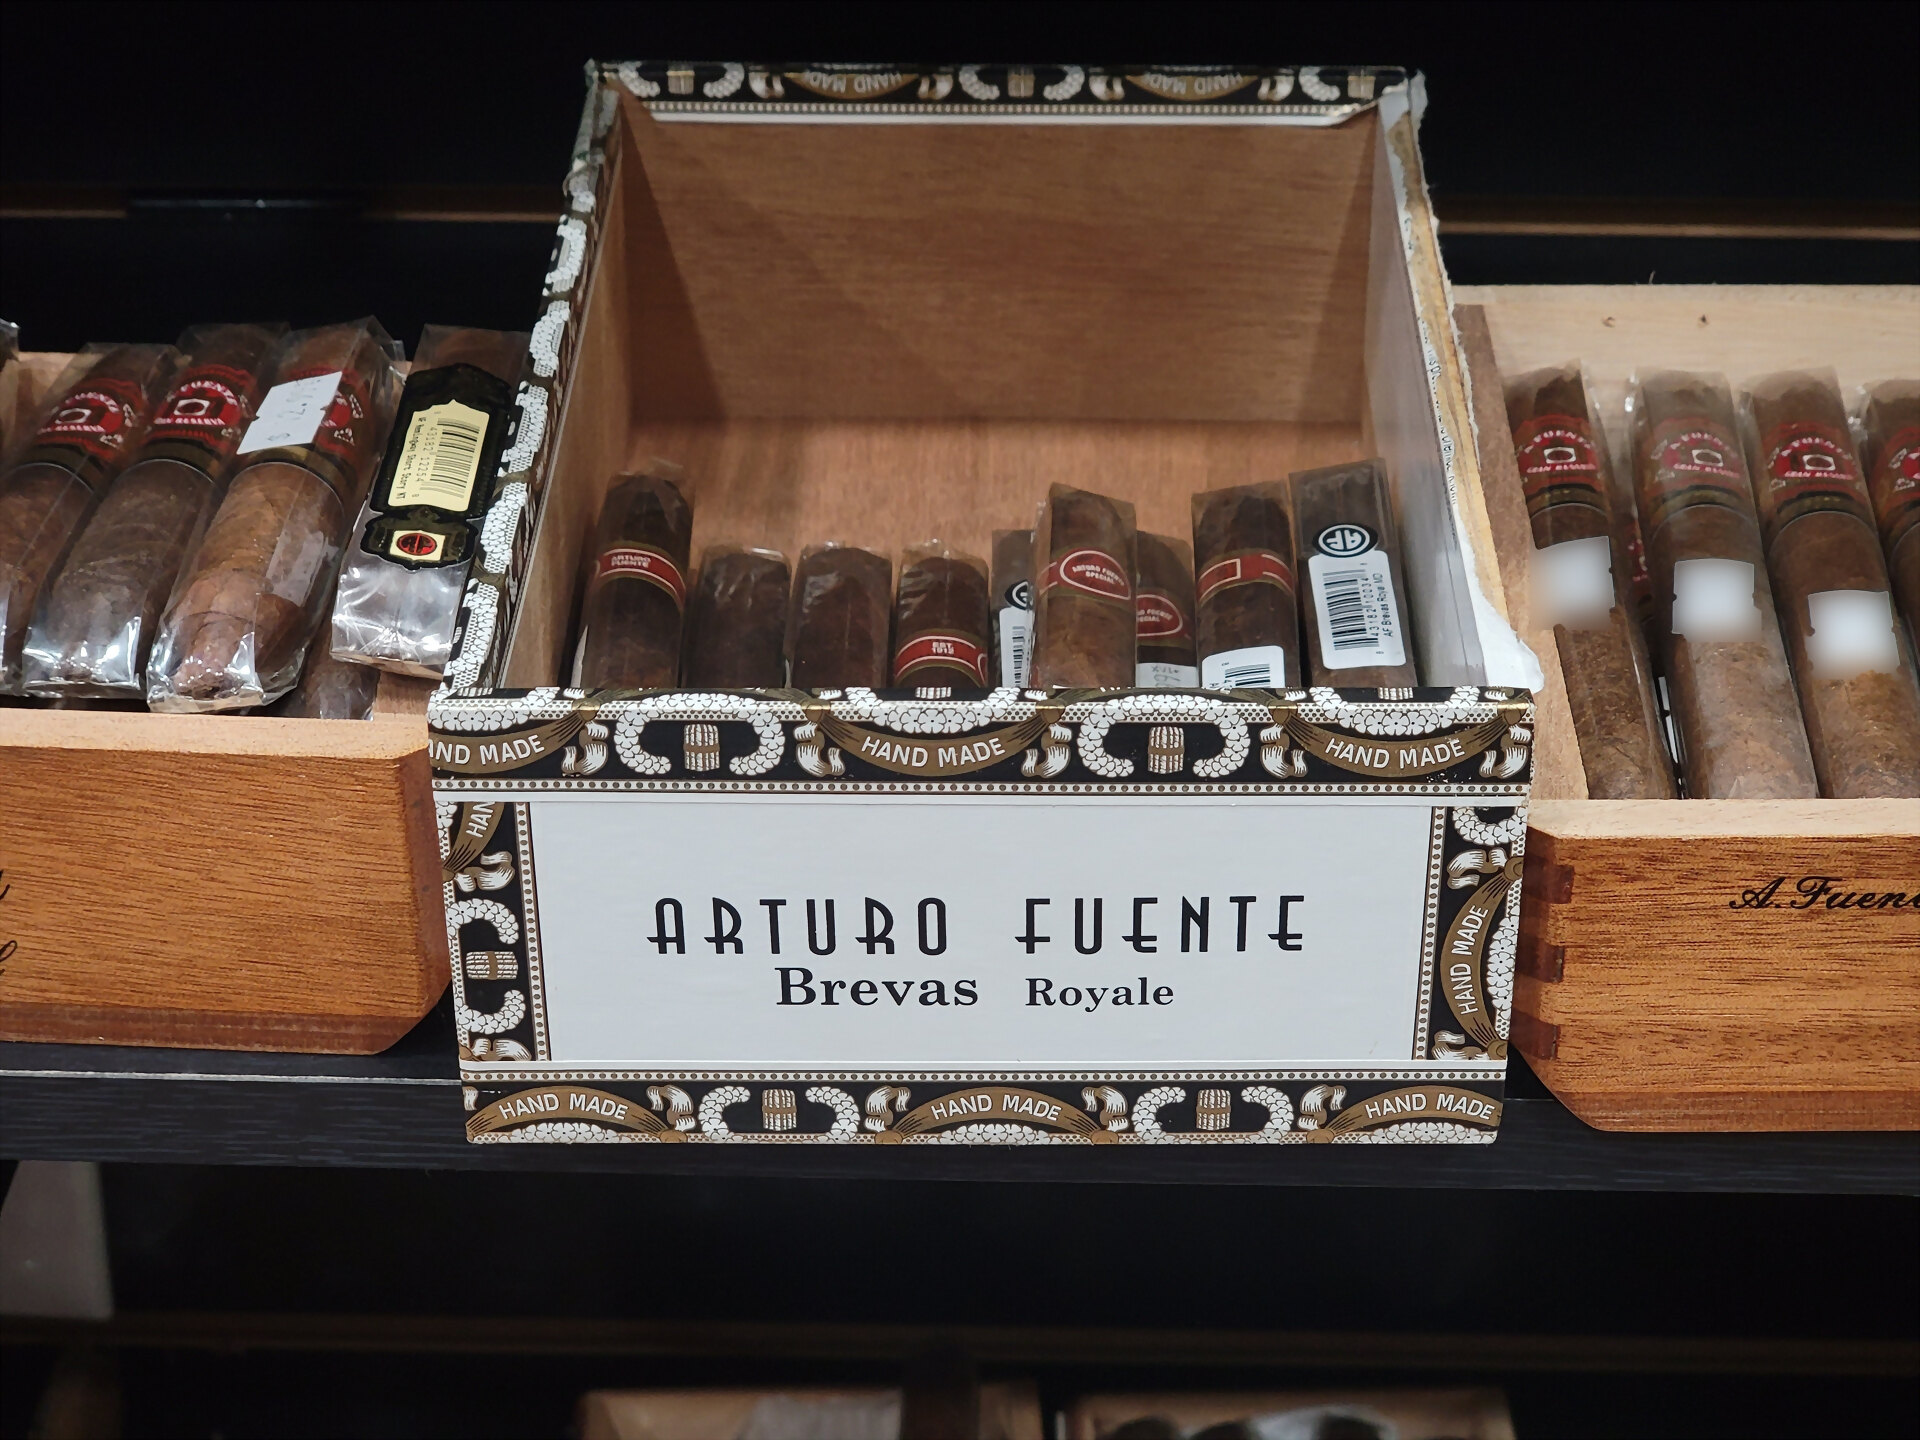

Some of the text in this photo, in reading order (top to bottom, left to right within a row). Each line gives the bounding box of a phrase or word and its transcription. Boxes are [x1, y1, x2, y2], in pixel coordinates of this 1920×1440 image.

[428, 734, 545, 765] AND MADE
[861, 736, 1005, 768] HAND MADE
[1325, 738, 1465, 769] HAND MADE
[465, 801, 496, 838] HAN
[1728, 876, 1786, 909] A.
[647, 895, 1305, 955] ARTURO FUENTE
[1449, 905, 1489, 1015] HAND MADE
[774, 966, 1174, 1013] Brevas Royale
[498, 1093, 628, 1120] HAND MADE
[931, 1094, 1062, 1121] HAND MADE
[1365, 1093, 1495, 1120] HAND MADE
